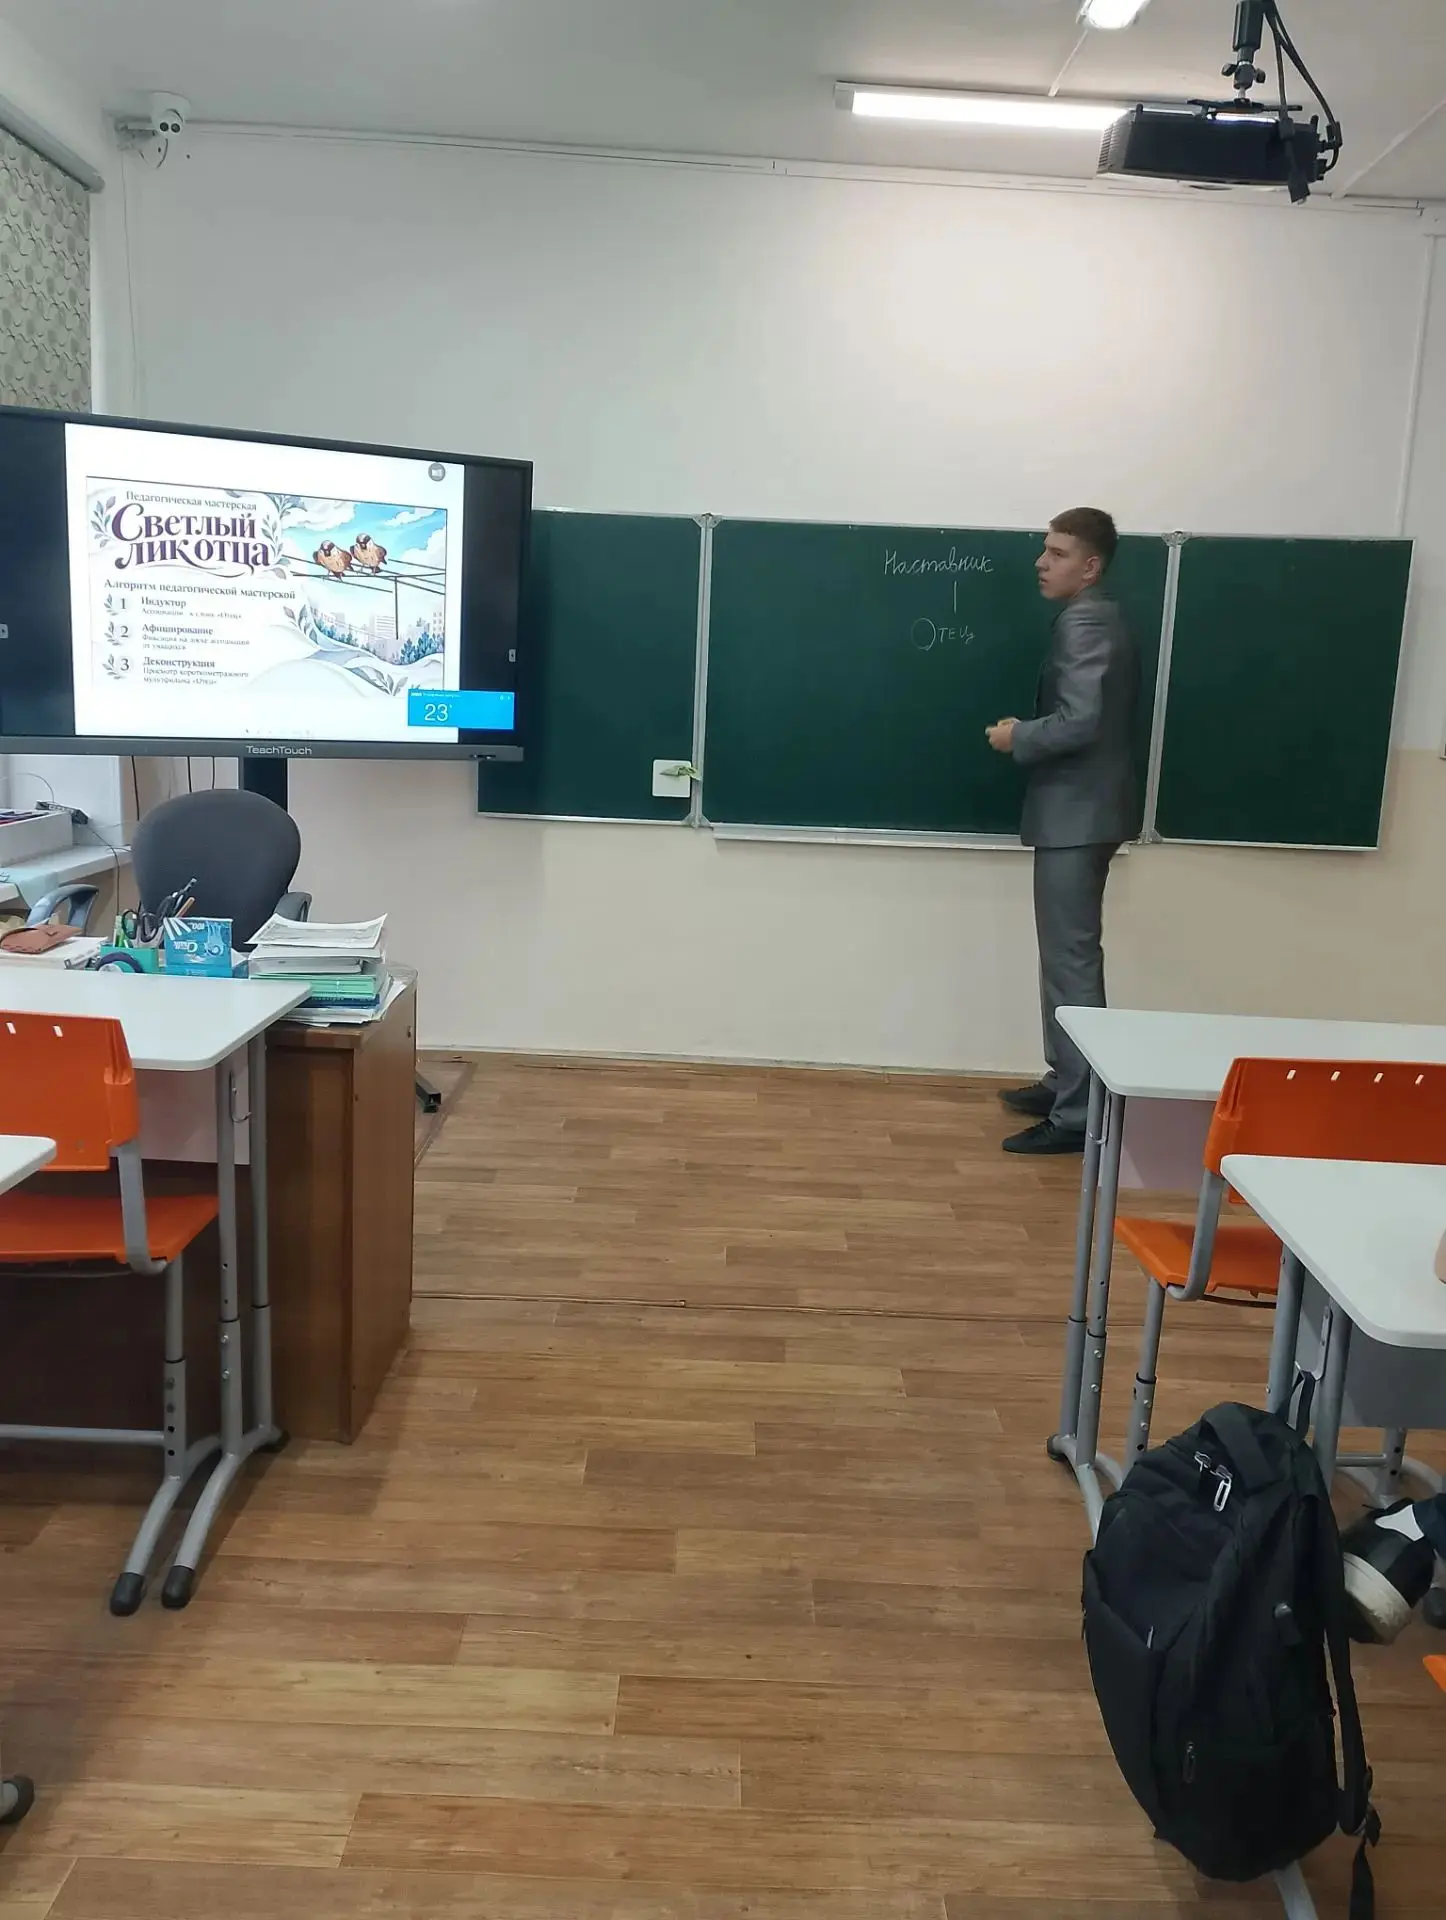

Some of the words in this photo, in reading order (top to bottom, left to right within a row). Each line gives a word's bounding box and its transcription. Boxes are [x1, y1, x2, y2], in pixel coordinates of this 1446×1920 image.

[125, 491, 201, 506] Педагогическая
[204, 500, 257, 512] мастерская
[111, 502, 257, 542] Светлый
[884, 545, 995, 576] Наставник
[104, 578, 156, 592] Алгоритм
[159, 584, 238, 597] педагогической
[240, 588, 296, 601] мастерской
[119, 597, 127, 610] 1
[119, 624, 130, 639] 2
[119, 657, 130, 672] 3
[142, 656, 216, 669] Деконструкция
[245, 744, 313, 756] TeachTouch
